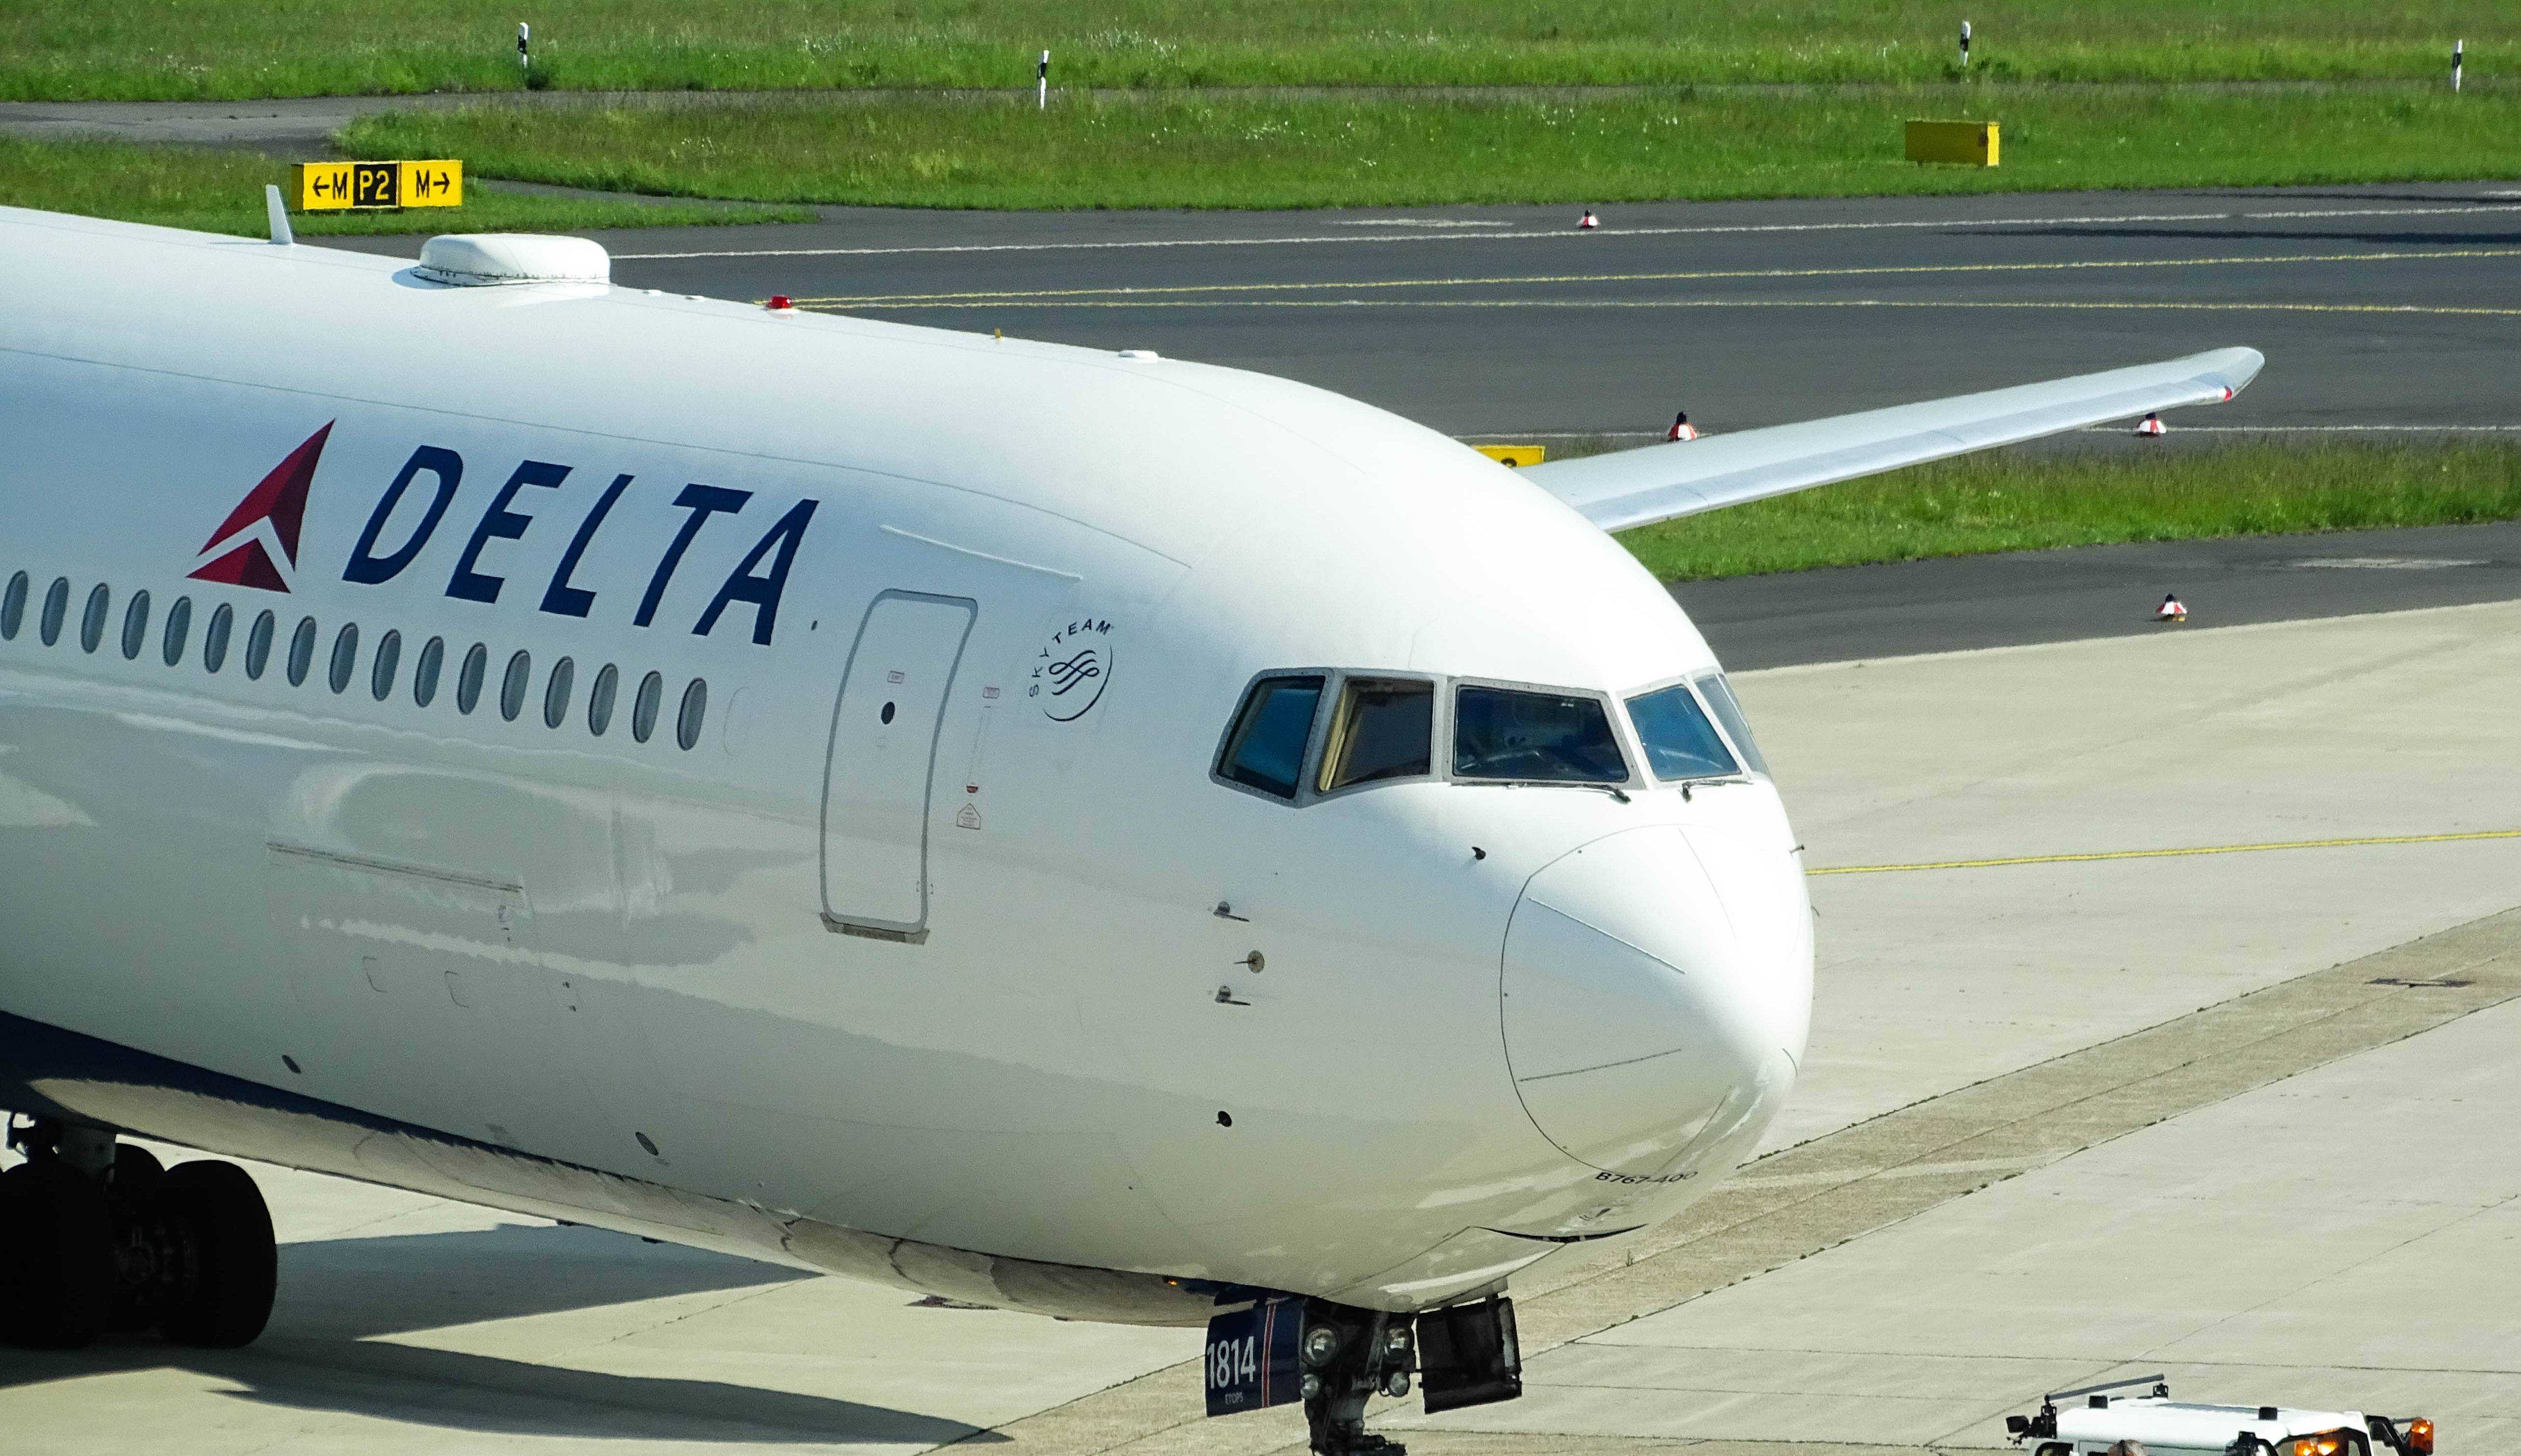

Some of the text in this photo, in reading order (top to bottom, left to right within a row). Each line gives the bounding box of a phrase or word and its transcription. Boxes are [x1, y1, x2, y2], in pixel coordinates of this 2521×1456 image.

[333, 170, 430, 201] M P2 M
[341, 444, 819, 646] DELTA
[1029, 618, 1111, 697] SKYTEAM
[1595, 1171, 1698, 1184] B767-400
[1207, 1335, 1256, 1389] 1814
